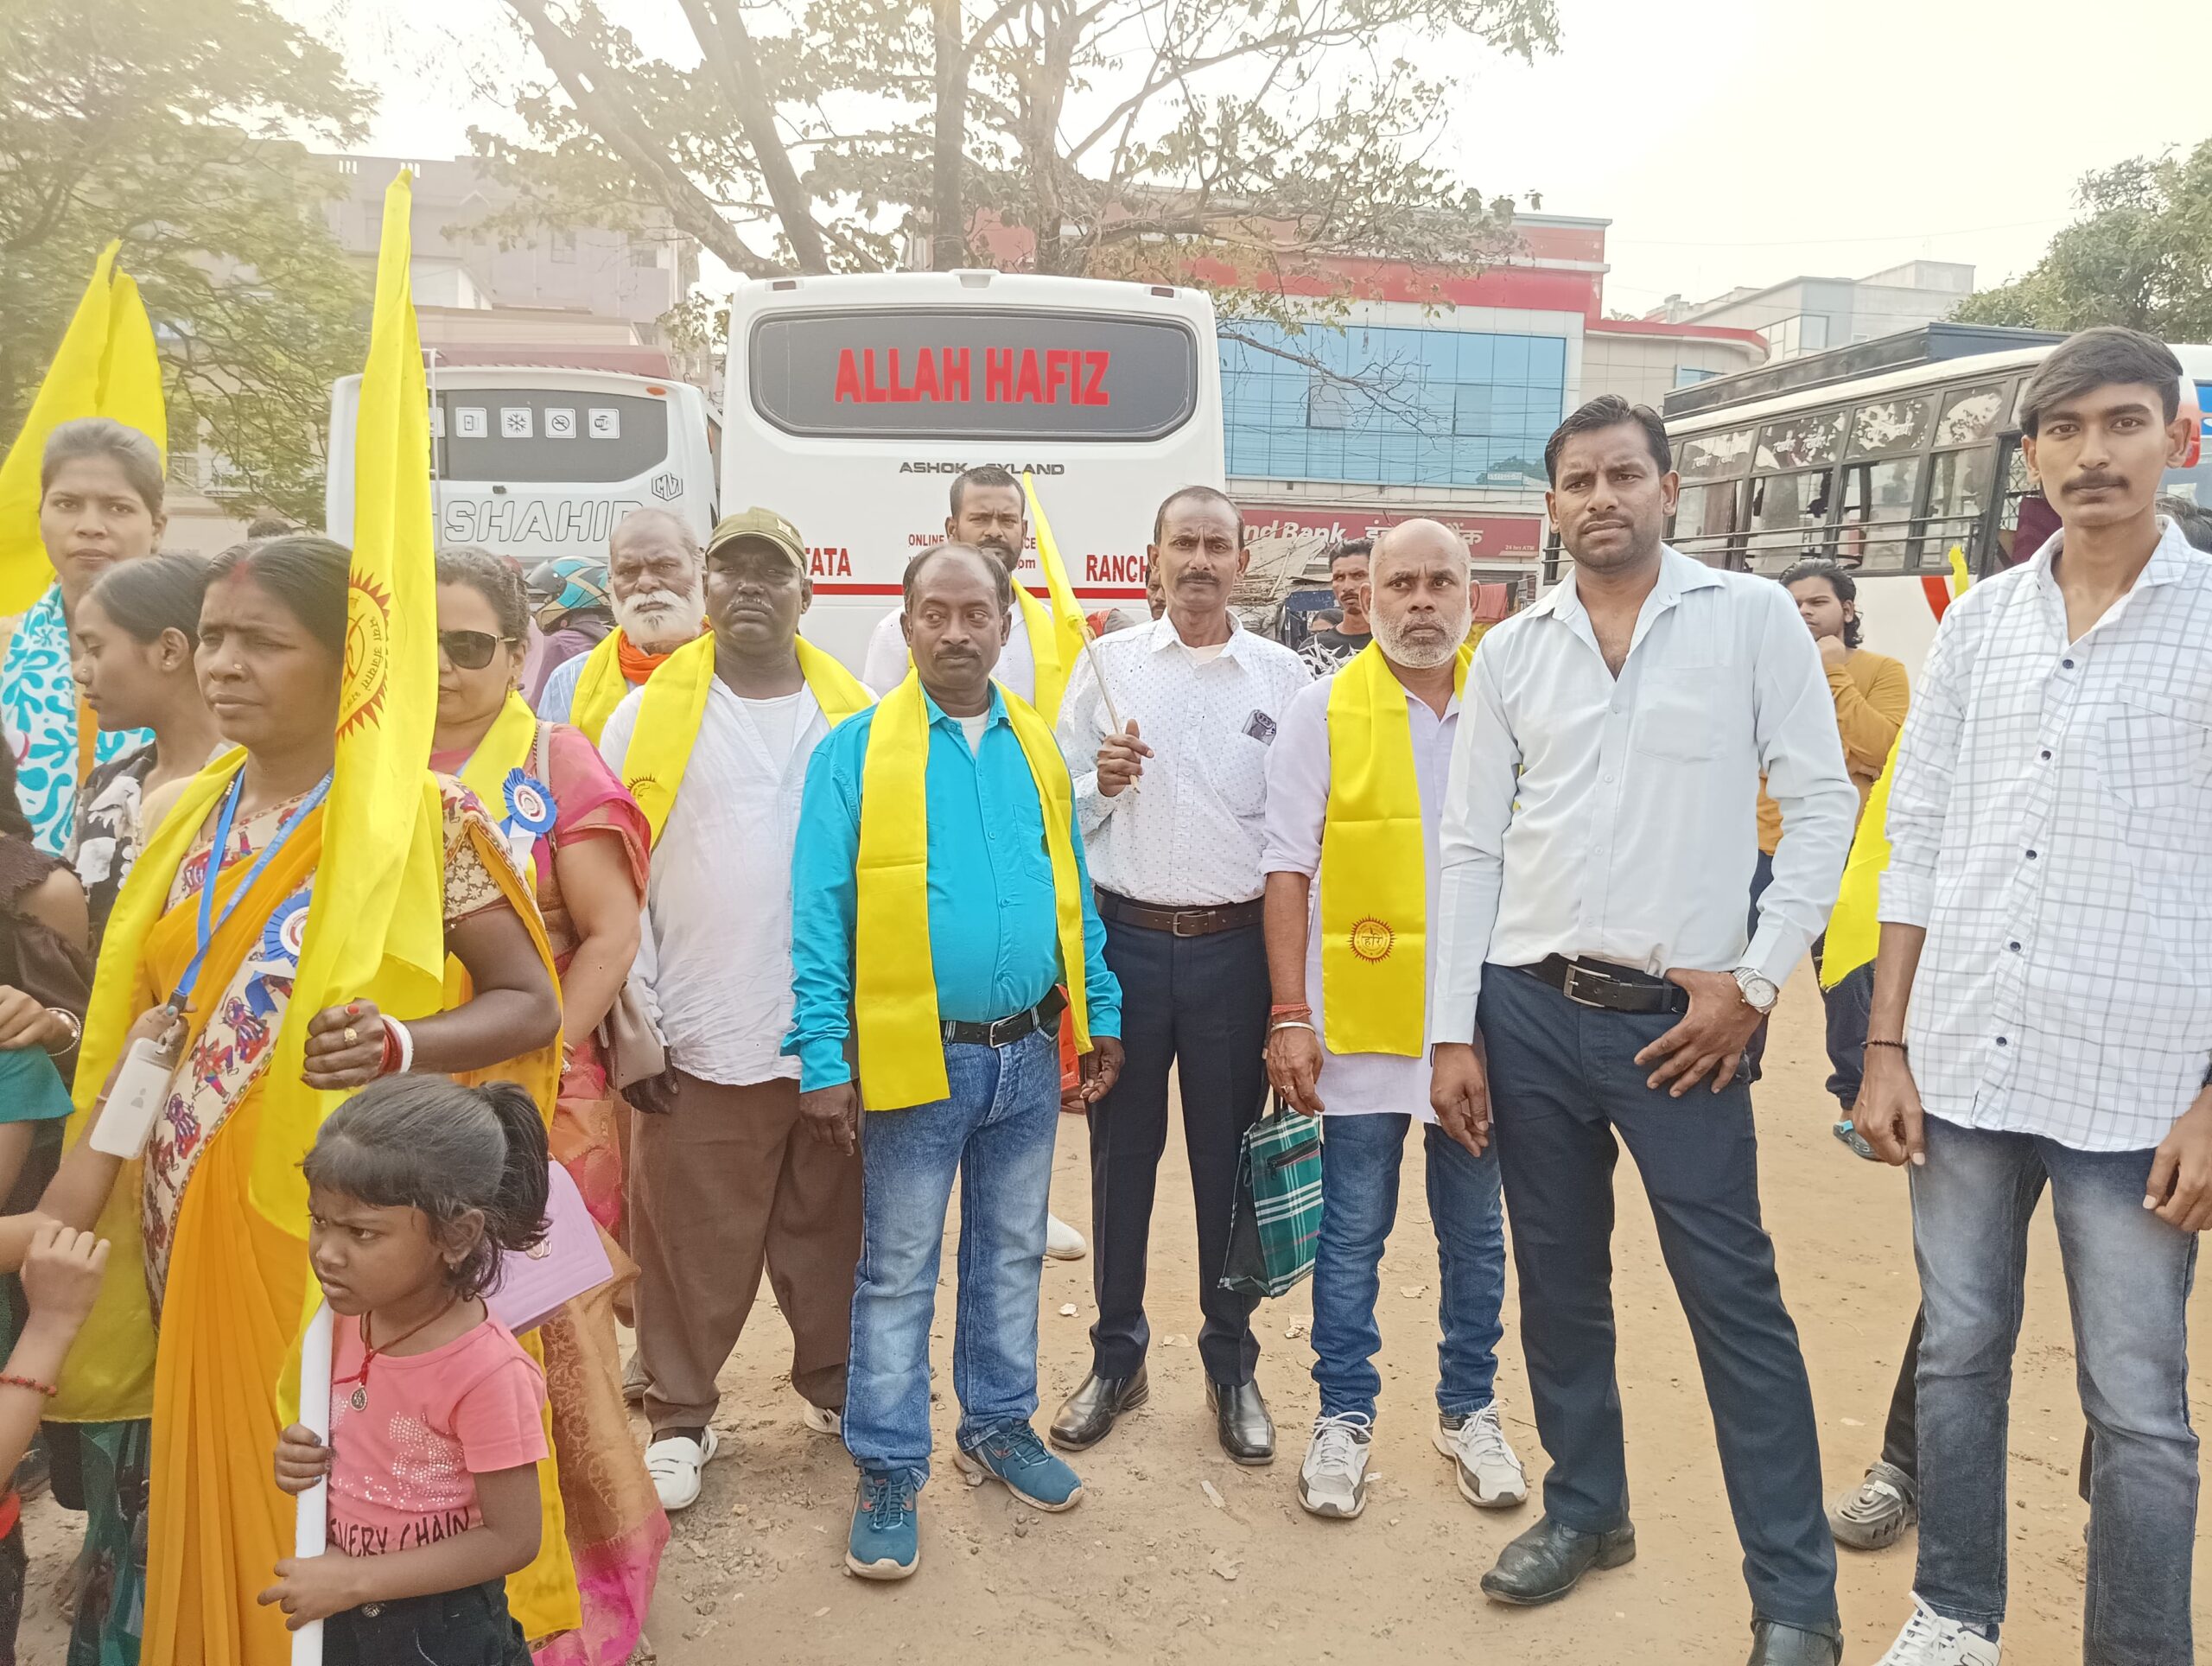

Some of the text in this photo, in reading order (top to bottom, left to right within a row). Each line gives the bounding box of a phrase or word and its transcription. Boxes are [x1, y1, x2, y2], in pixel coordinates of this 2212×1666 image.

[834, 347, 1110, 406] ALLAH HAFIZ
[899, 461, 969, 474] ASHOK
[1281, 521, 1347, 544] Bank
